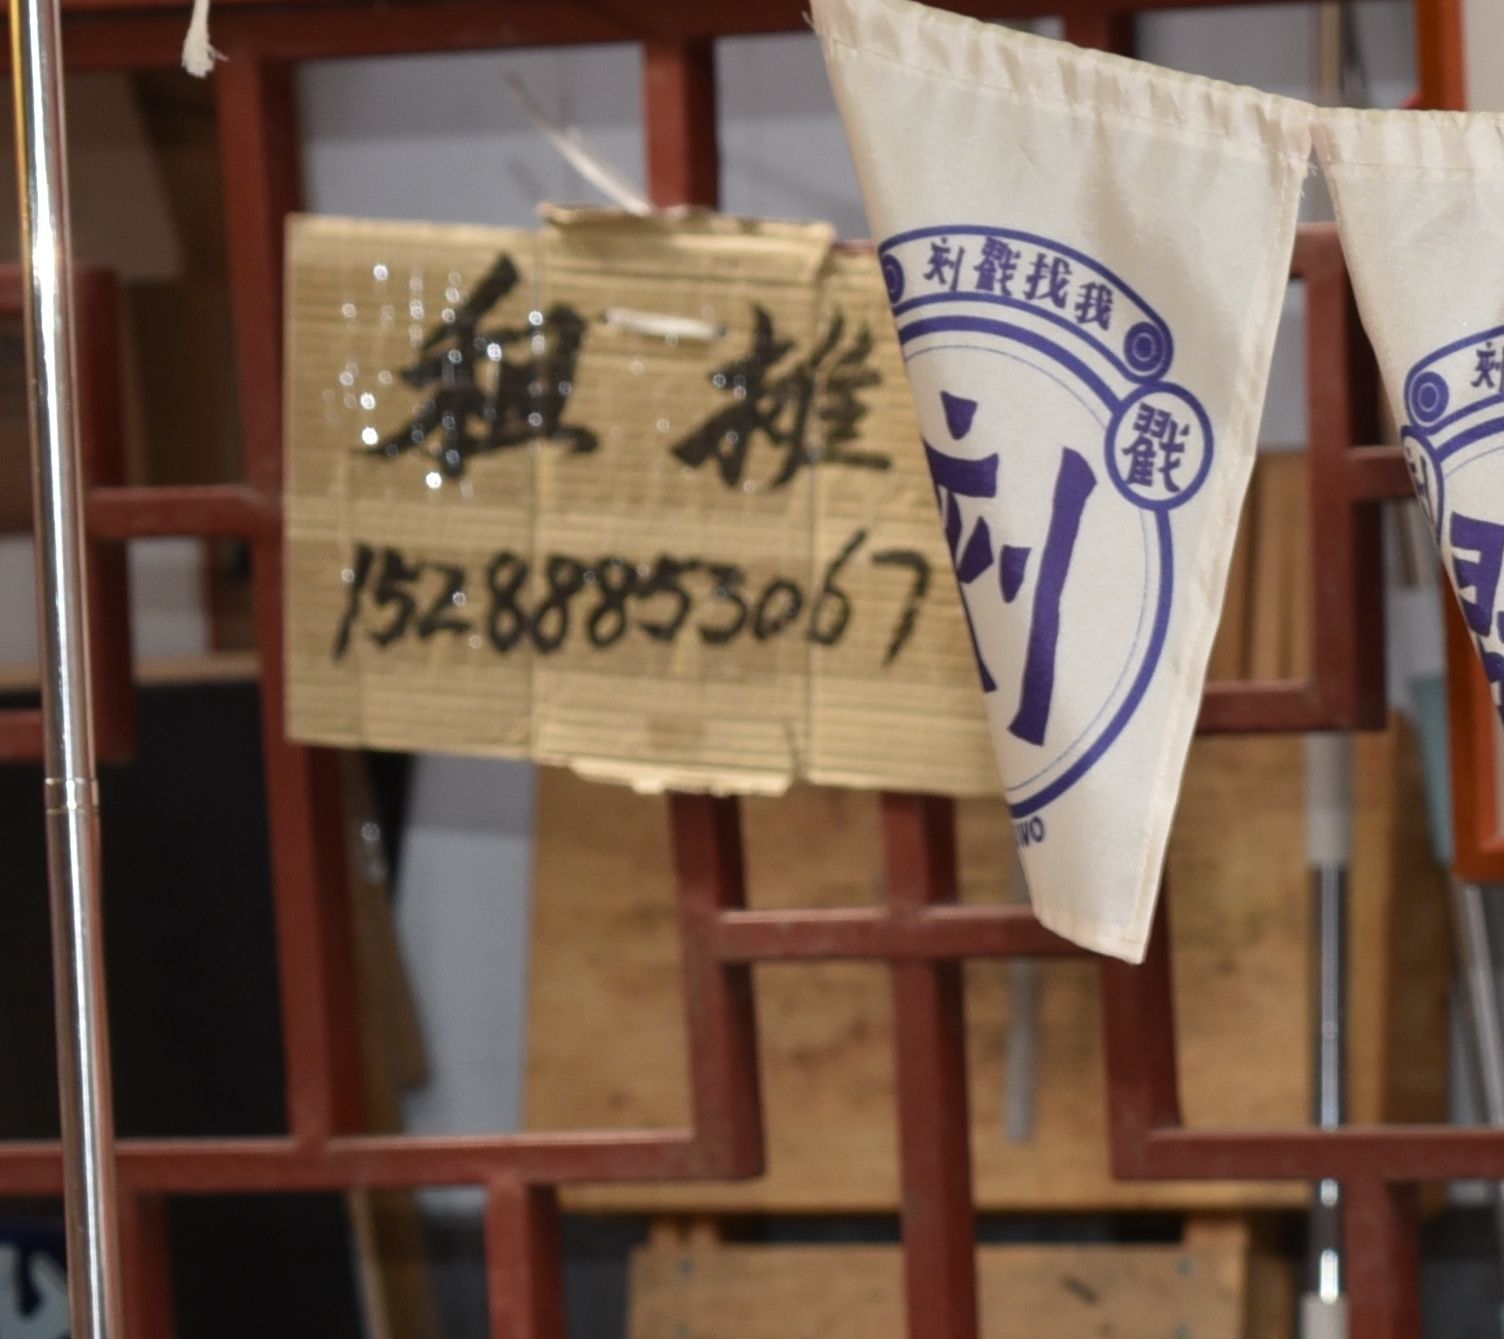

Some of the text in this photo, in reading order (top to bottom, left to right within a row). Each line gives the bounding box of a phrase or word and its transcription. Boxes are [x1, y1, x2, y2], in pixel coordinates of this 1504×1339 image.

[923, 236, 1114, 331] 刻戳找我
[1122, 402, 1191, 493] 戳
[333, 529, 932, 668] 15288853067
